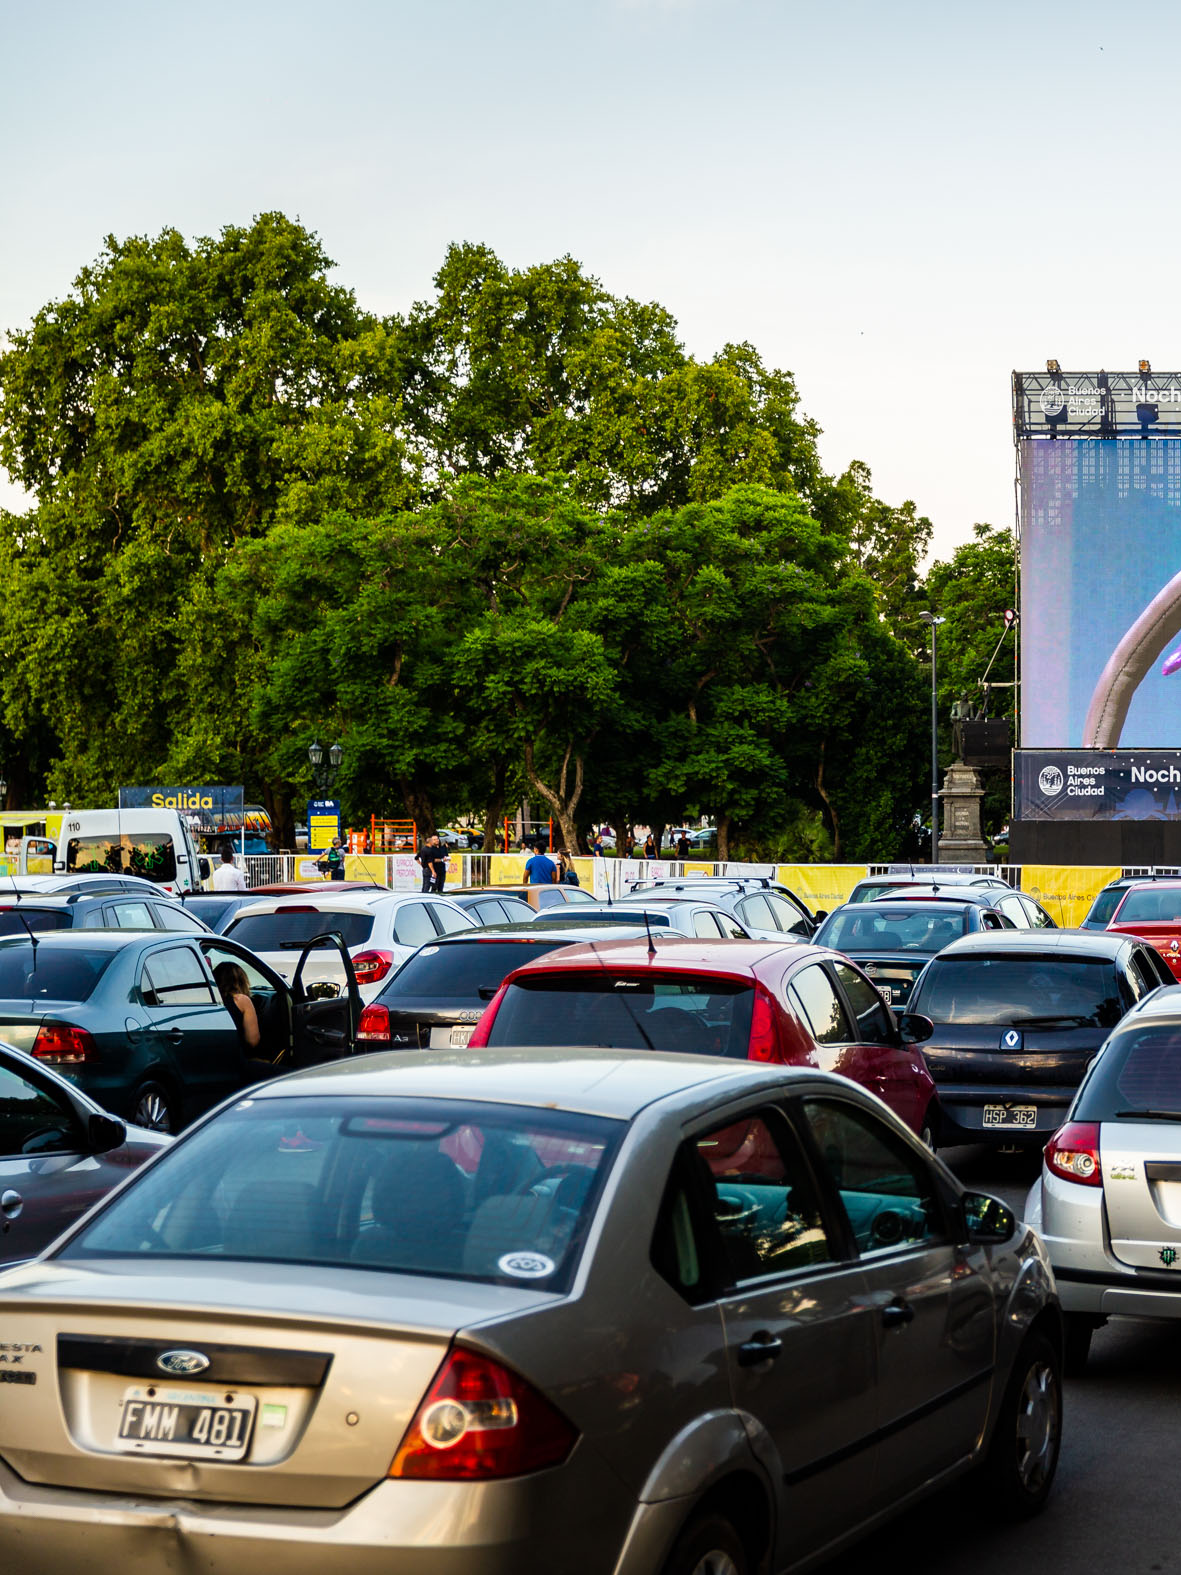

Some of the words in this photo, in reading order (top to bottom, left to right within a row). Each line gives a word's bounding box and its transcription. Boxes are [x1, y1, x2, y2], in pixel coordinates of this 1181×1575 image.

[1068, 386, 1106, 396] Buenos
[1068, 396, 1096, 406] Aires
[1068, 406, 1106, 417] Ciudad
[1067, 766, 1106, 776] Buenos
[1067, 776, 1096, 786] Aires
[1067, 786, 1105, 796] Ciudad
[151, 793, 213, 809] Salida
[68, 822, 81, 832] 110
[1043, 892, 1067, 901] Buenos
[1068, 893, 1085, 901] Aires
[985, 1110, 1007, 1123] HSP
[1012, 1111, 1035, 1124] 362
[121, 1402, 180, 1441] FMM
[191, 1408, 243, 1447] 481
